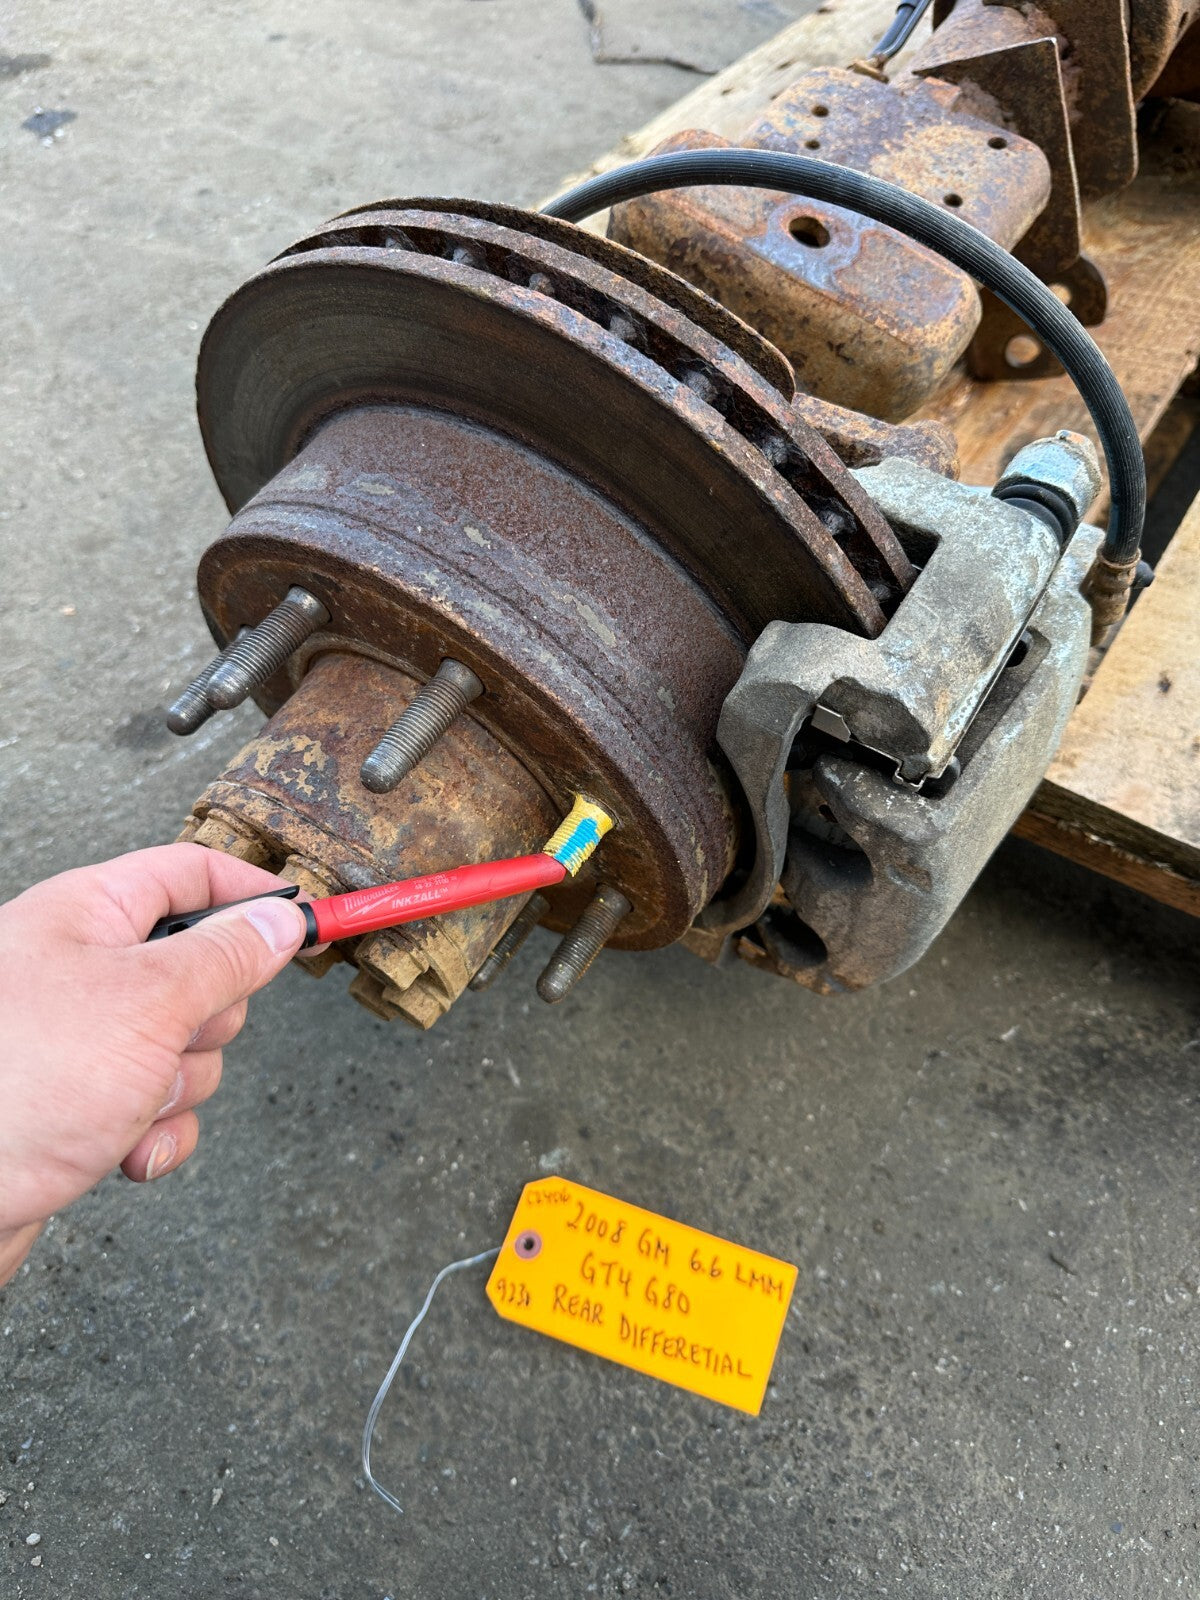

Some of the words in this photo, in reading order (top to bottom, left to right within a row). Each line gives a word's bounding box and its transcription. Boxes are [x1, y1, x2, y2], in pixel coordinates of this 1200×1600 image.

[341, 885, 400, 912] Milwaukee
[566, 1201, 626, 1244] 2008
[637, 1228, 669, 1266] GM
[690, 1248, 722, 1278] 6.6
[735, 1262, 784, 1302] LMM
[580, 1252, 632, 1297] GT4
[645, 1276, 690, 1315] G80
[552, 1283, 604, 1325] REAR
[620, 1313, 753, 1378] DIFFERETIAL
